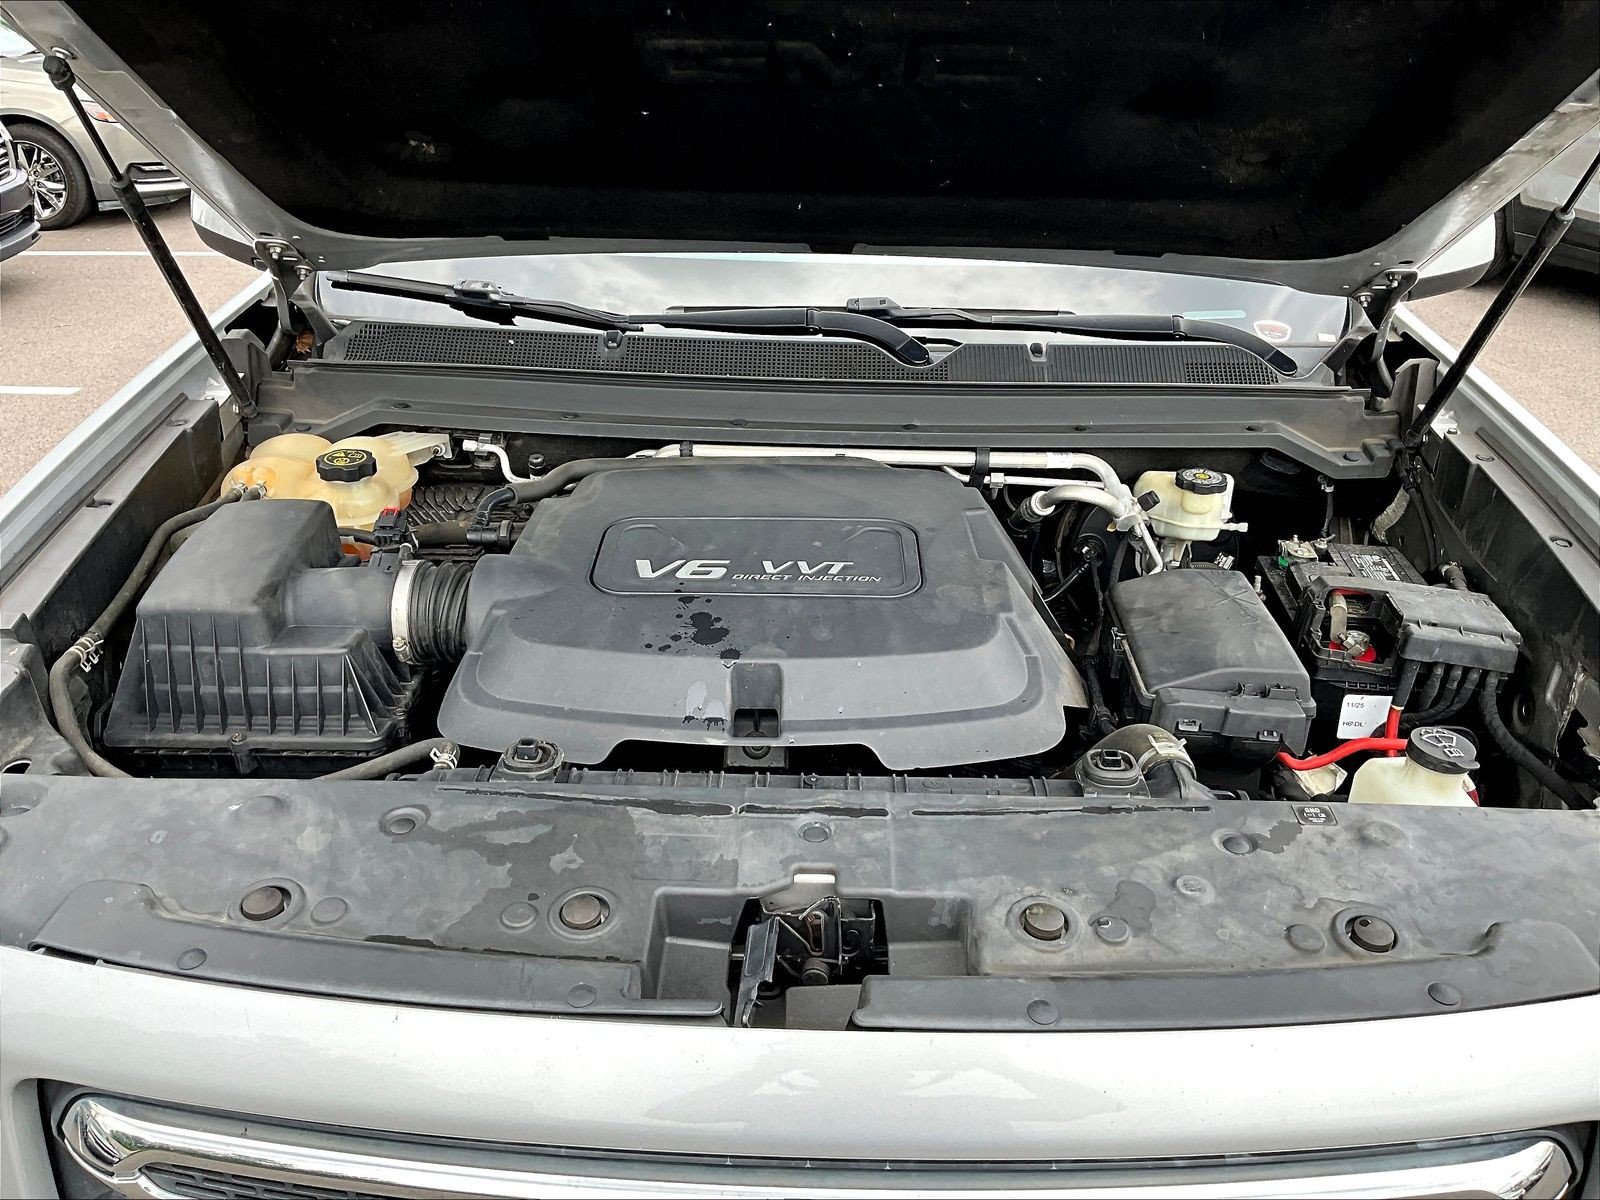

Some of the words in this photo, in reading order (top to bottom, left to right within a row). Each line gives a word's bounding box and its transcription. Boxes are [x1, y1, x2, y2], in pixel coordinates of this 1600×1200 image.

[636, 559, 731, 579] V6
[762, 560, 854, 575] VVT
[797, 574, 881, 583] INJECTION
